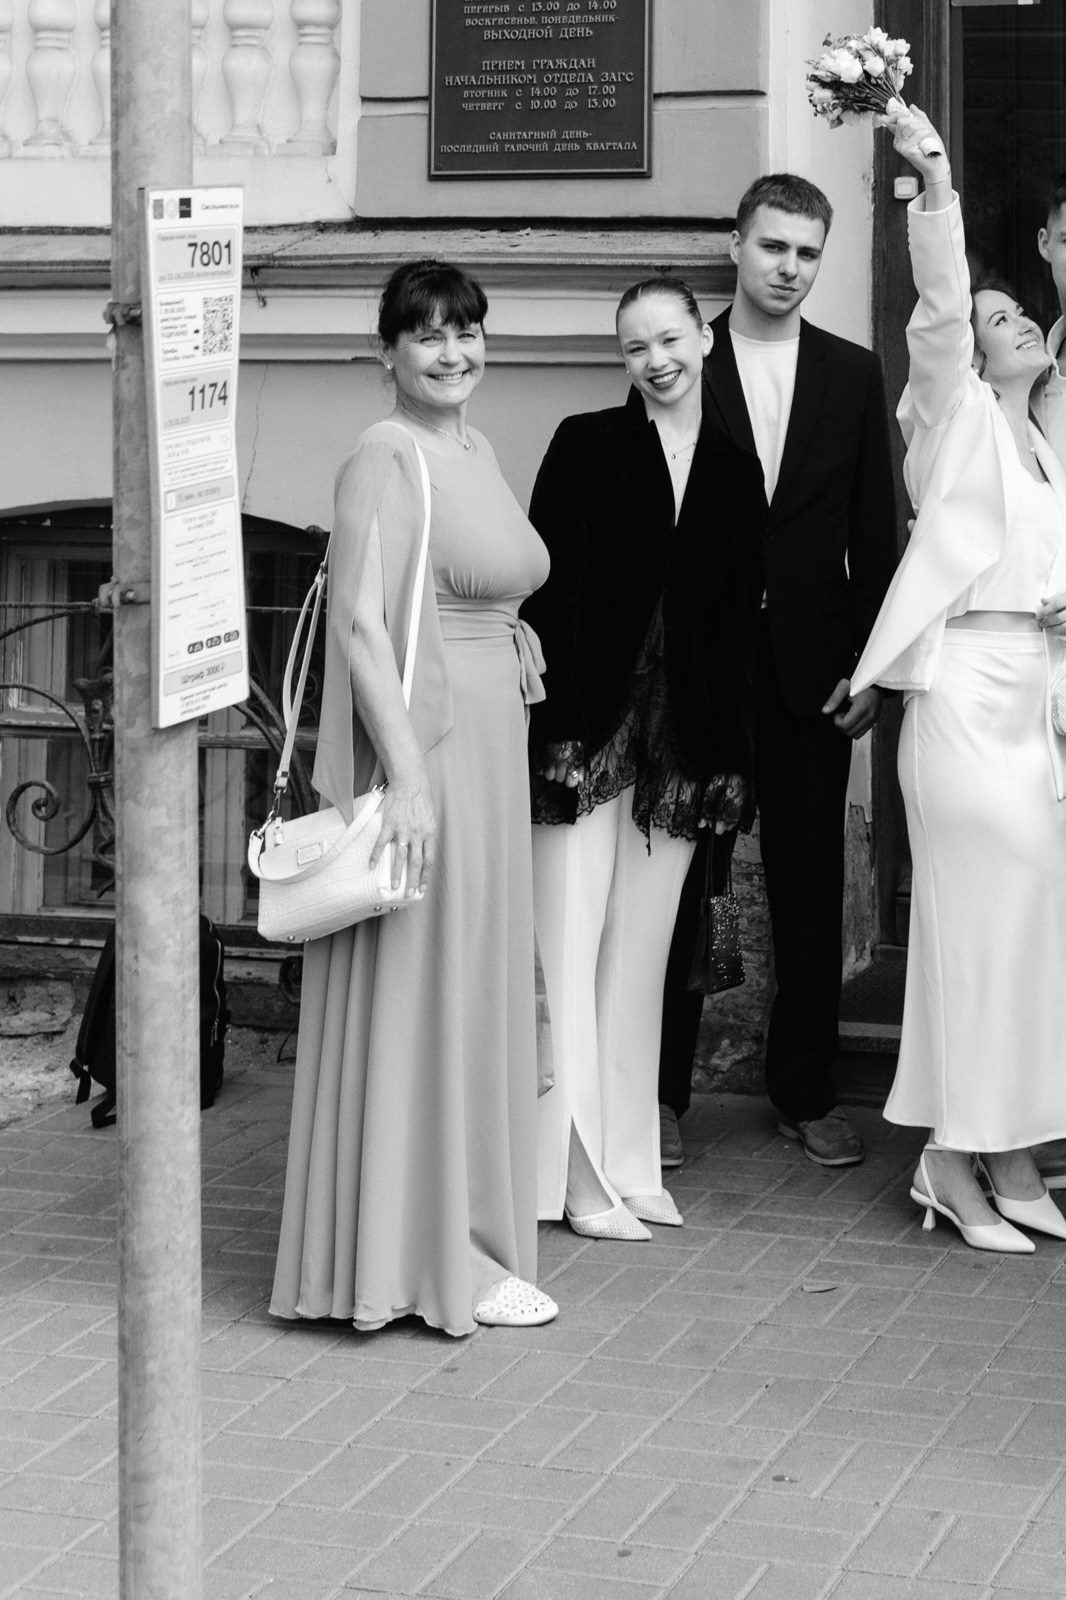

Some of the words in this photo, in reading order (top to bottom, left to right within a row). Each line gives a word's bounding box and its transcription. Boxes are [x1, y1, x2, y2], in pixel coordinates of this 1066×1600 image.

[464, 5, 510, 14] ПЕРЕРЫВ
[532, 2, 560, 11] 13.00
[588, 0, 617, 10] 14.00
[484, 26, 552, 40] ВЫХОДНОЙ
[559, 27, 593, 39] ДЕНЬ
[482, 60, 525, 71] ПРИЕМ
[533, 58, 596, 69] ГРАЖДАН
[445, 74, 537, 86] НАЧАЛЬНИКОМ
[544, 73, 594, 85] ОТДЕЛА
[601, 72, 634, 82] ЗАГС
[463, 89, 507, 98] ВТОРНИК
[531, 87, 557, 97] 14.00
[588, 85, 615, 96] 17.00
[462, 102, 504, 111] ЧЕТВЕРГ
[531, 100, 557, 110] 10.00
[588, 99, 616, 109] 13.00
[489, 131, 557, 140] САНИТАРНЫЙ
[440, 142, 499, 154] ПОСЛЕДНИЙ
[505, 142, 549, 152] РАБОЧИЙ
[553, 143, 580, 152] ДЕНЬ
[586, 142, 637, 151] КВАРТАЛА
[188, 240, 231, 267] 7801
[189, 380, 228, 411] 1174
